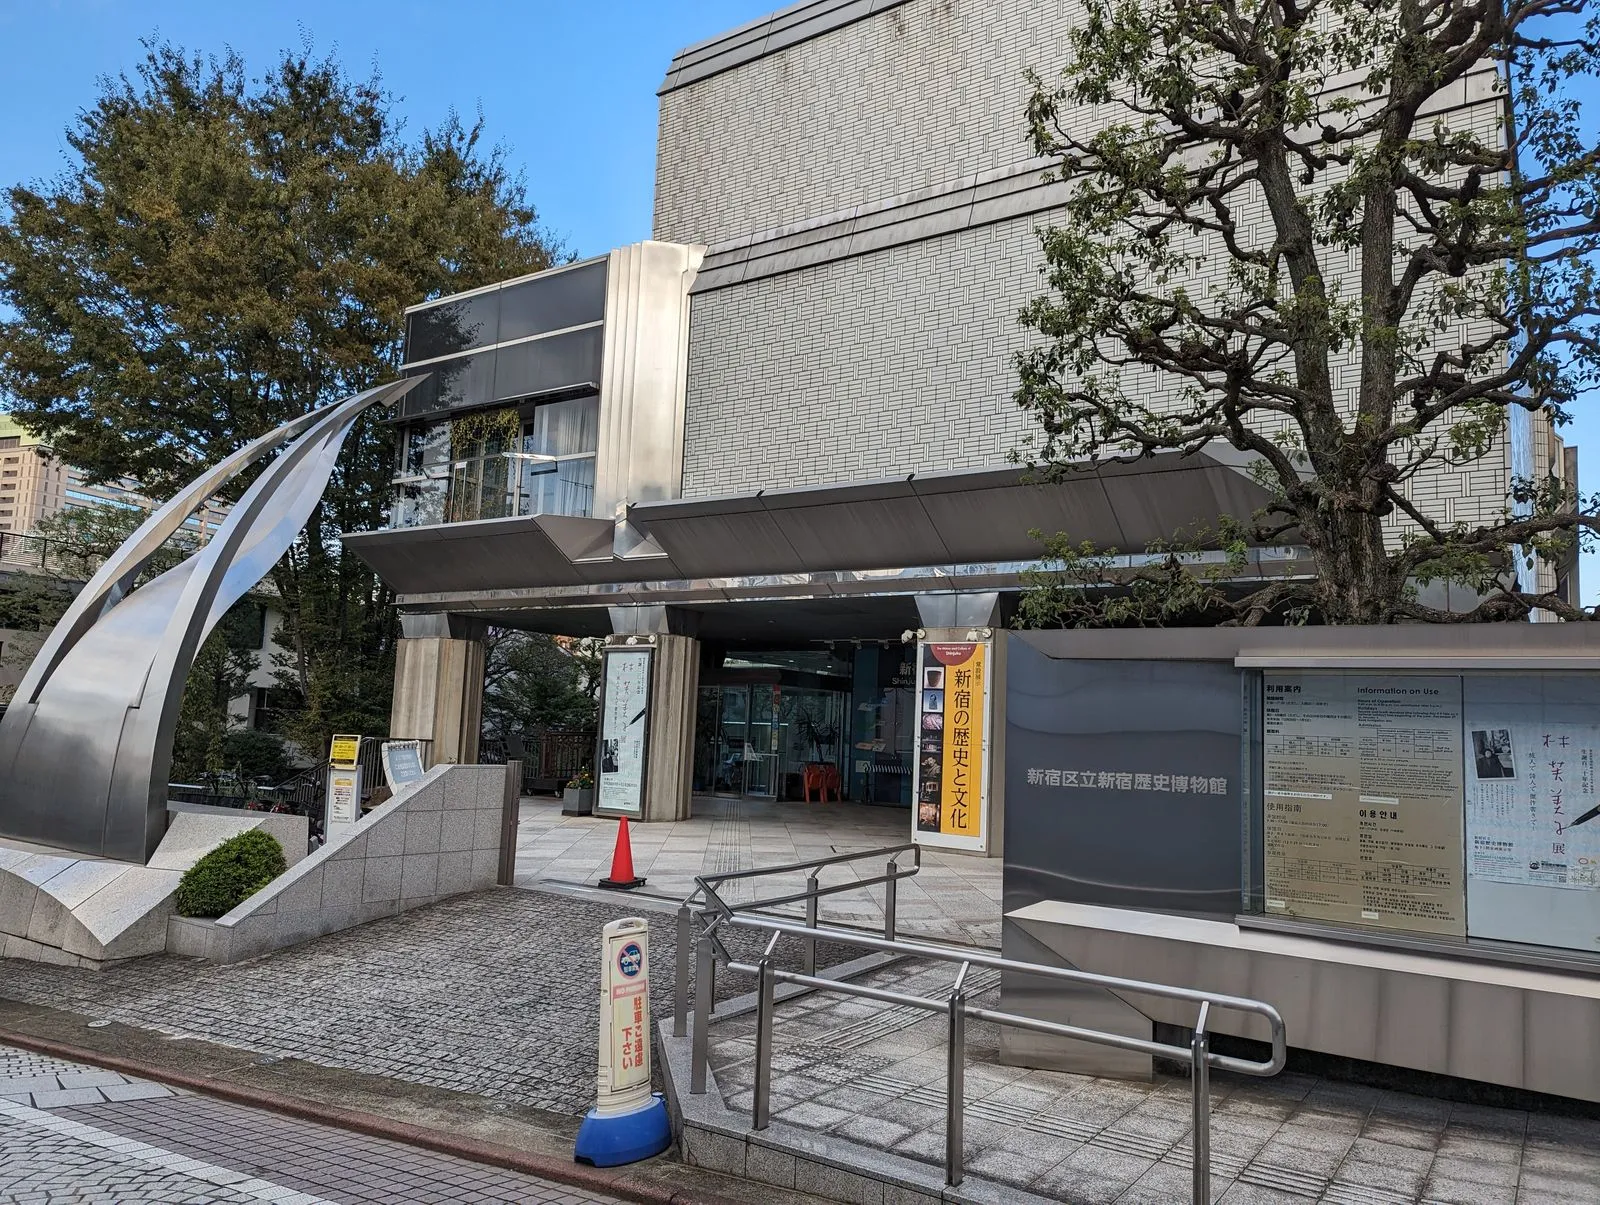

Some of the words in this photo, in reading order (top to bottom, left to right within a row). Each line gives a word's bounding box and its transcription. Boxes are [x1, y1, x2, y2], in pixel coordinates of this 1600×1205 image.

[1266, 685, 1301, 693] 利用案内
[1357, 687, 1407, 695] Information
[949, 668, 972, 829] 新宿の歴史と文化
[1027, 768, 1228, 795] 新宿区立新宿歴史博物館
[1266, 802, 1302, 812] 使用指南
[621, 1027, 632, 1069] 下さい
